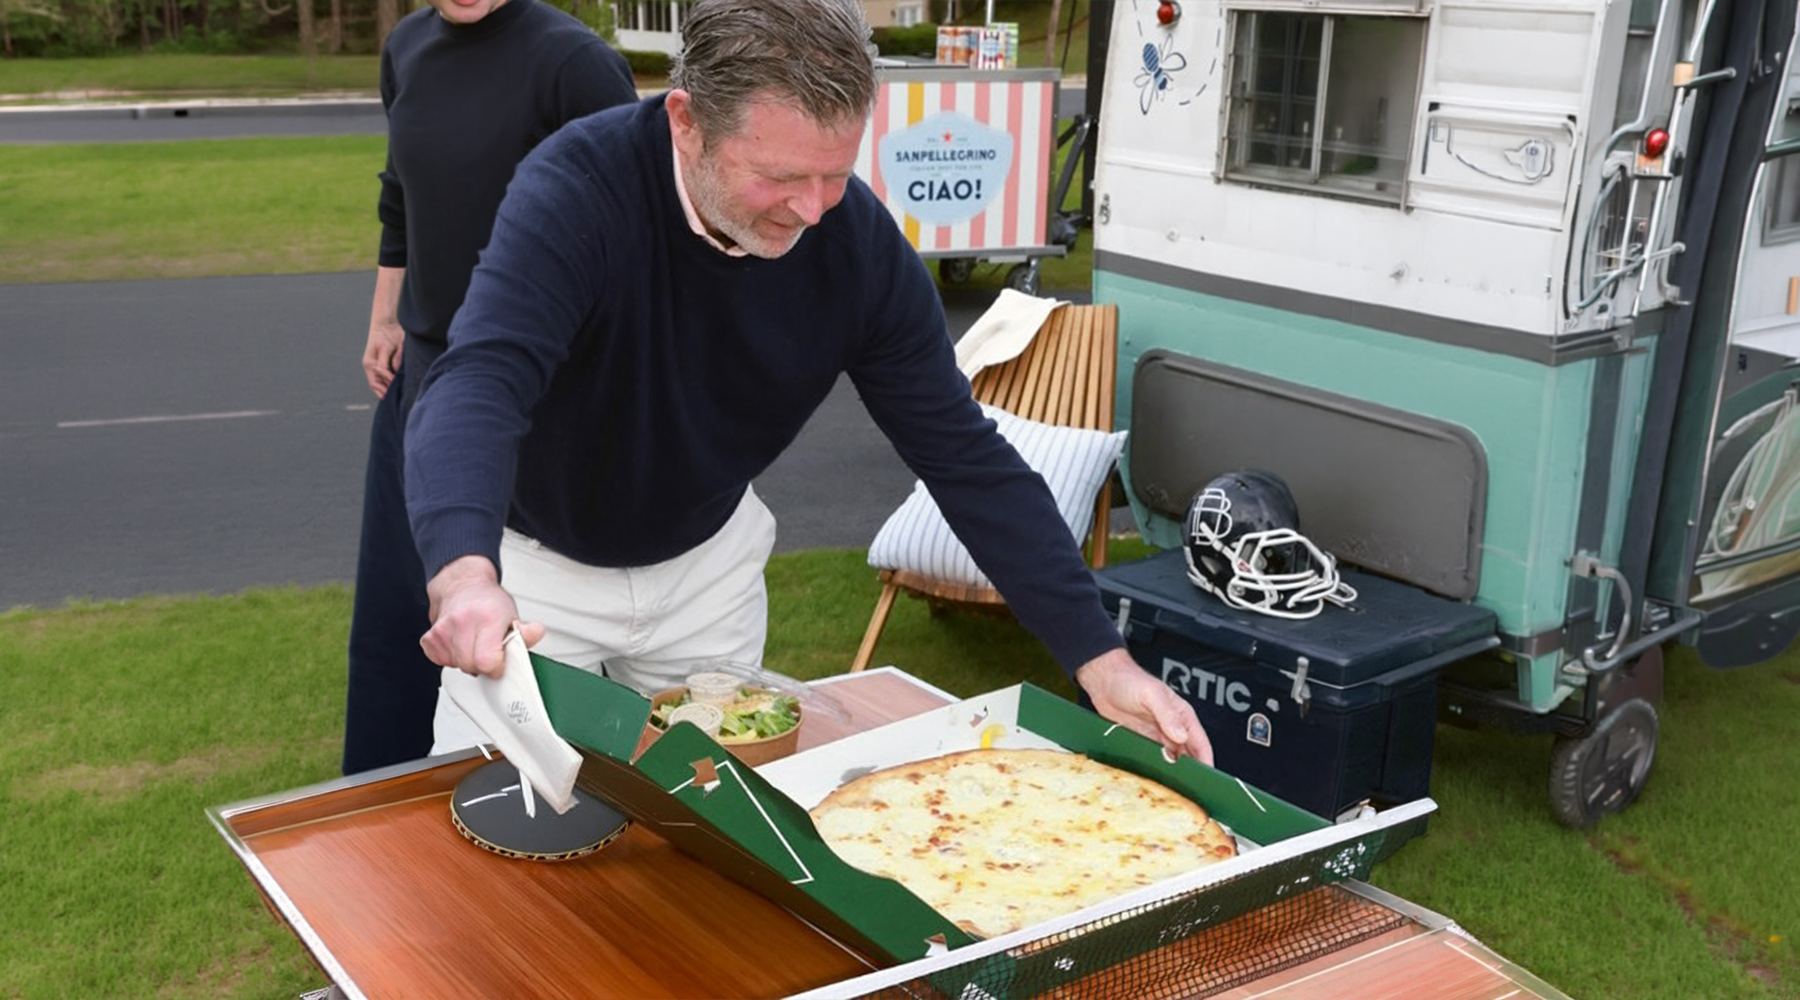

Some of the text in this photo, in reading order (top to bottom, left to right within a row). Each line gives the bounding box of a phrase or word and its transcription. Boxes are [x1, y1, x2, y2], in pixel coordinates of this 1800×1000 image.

[895, 149, 997, 162] SANPELLEGRINO
[908, 179, 982, 202] CIAO!
[1162, 657, 1251, 712] RTIC
